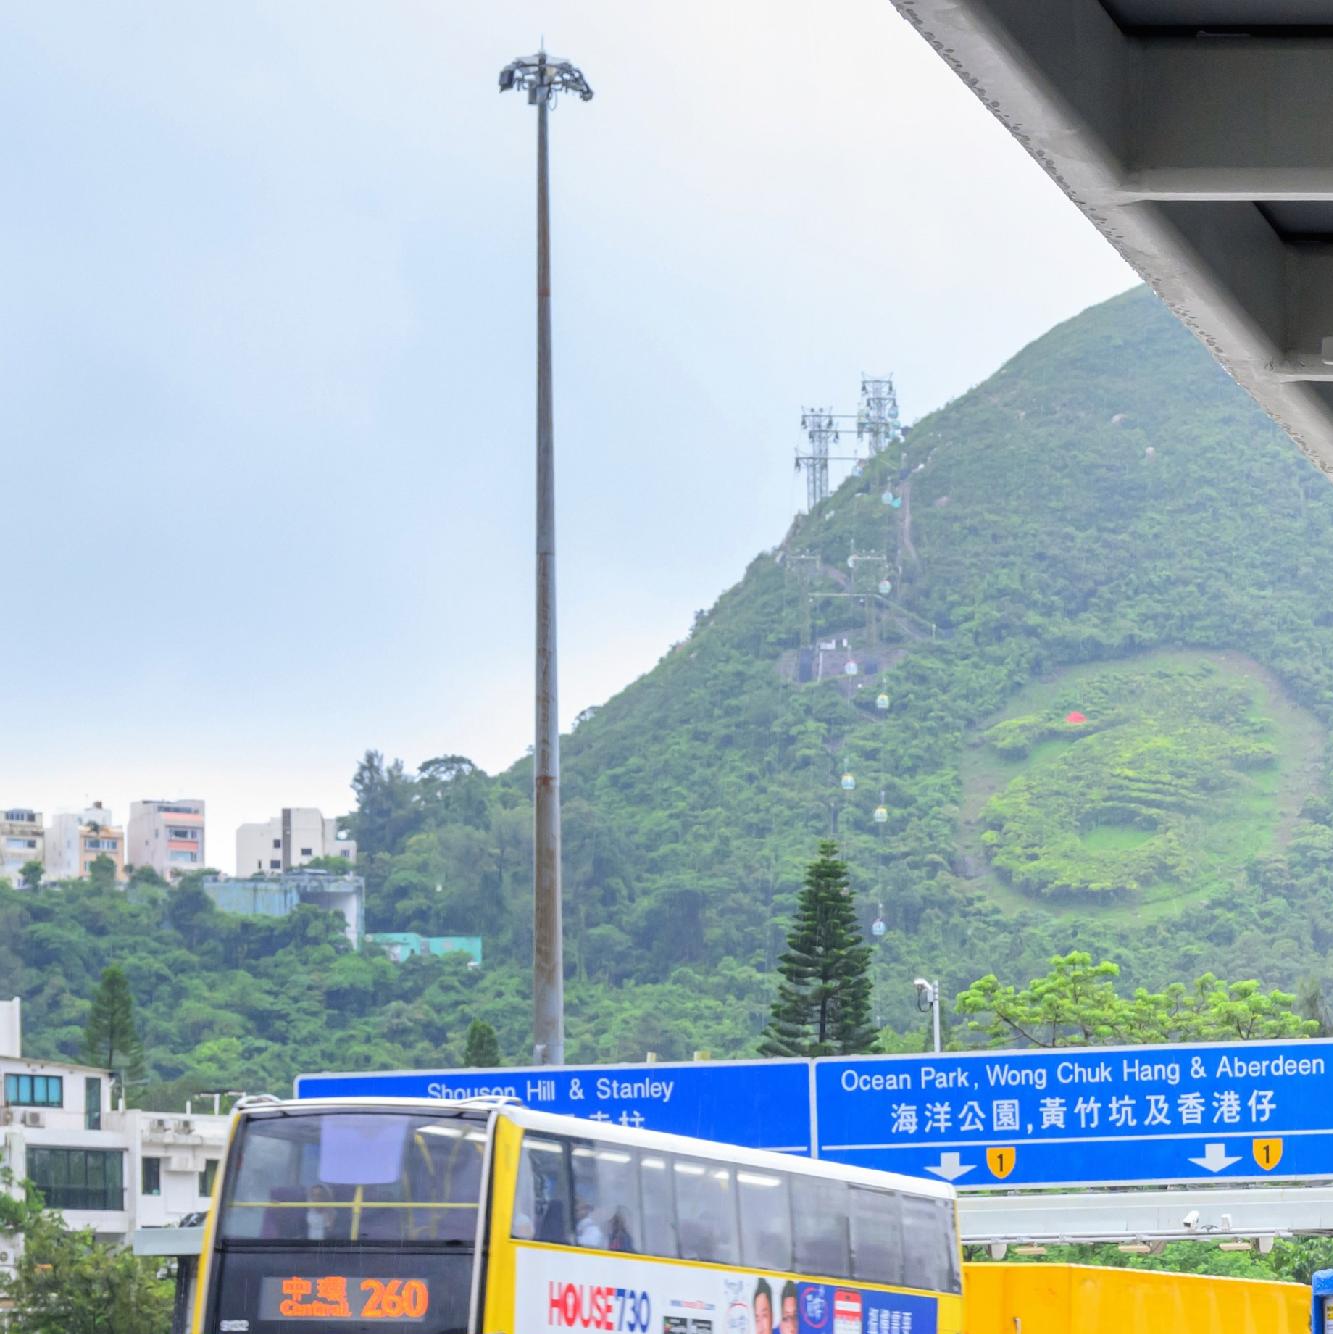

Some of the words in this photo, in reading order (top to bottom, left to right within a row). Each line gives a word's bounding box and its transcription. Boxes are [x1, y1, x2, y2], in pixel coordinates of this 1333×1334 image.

[526, 1078, 556, 1101] Hill
[569, 1078, 585, 1099] &
[595, 1077, 675, 1103] Stanley
[840, 1067, 912, 1093] Ocean
[986, 1063, 1048, 1090] Wong
[1056, 1060, 1113, 1084] Chuk
[1121, 1058, 1181, 1086] Hang
[1190, 1057, 1207, 1079] &
[1216, 1054, 1325, 1080] Aberdeen
[997, 1152, 1006, 1173] 1
[1262, 1143, 1271, 1165] 1
[360, 1278, 429, 1319] 260
